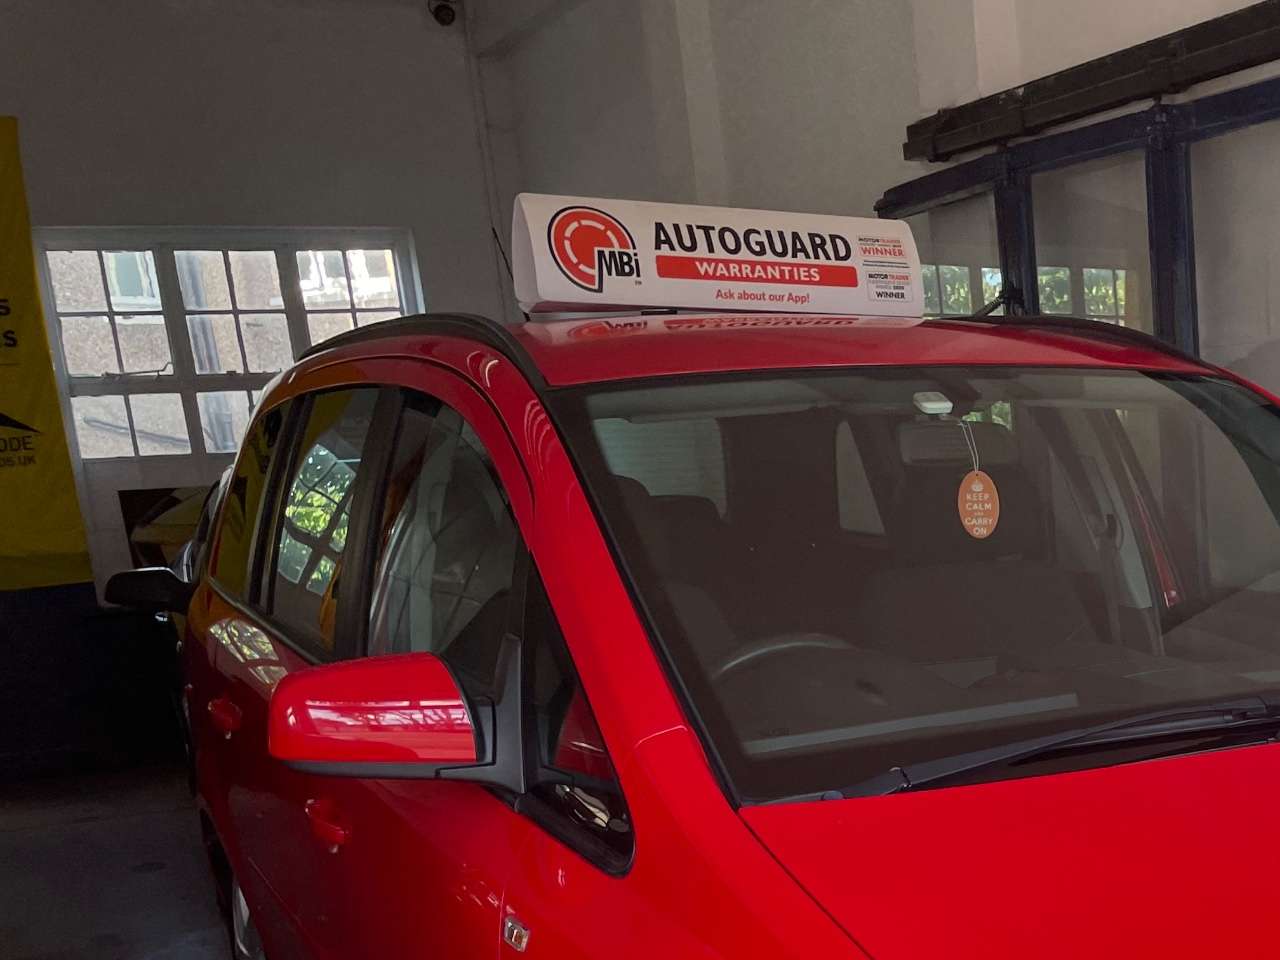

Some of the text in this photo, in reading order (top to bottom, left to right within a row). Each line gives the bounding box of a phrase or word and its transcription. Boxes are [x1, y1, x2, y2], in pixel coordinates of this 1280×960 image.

[653, 220, 852, 262] AUTOGUARD
[860, 246, 905, 257] WINNER
[695, 261, 821, 282] WARRANTIES
[715, 289, 810, 305] Ask about our App!
[876, 291, 905, 299] WINNER
[965, 493, 990, 501] KEEP
[966, 502, 992, 511] CALM
[964, 517, 993, 526] CARRY
[973, 527, 987, 536] ON
